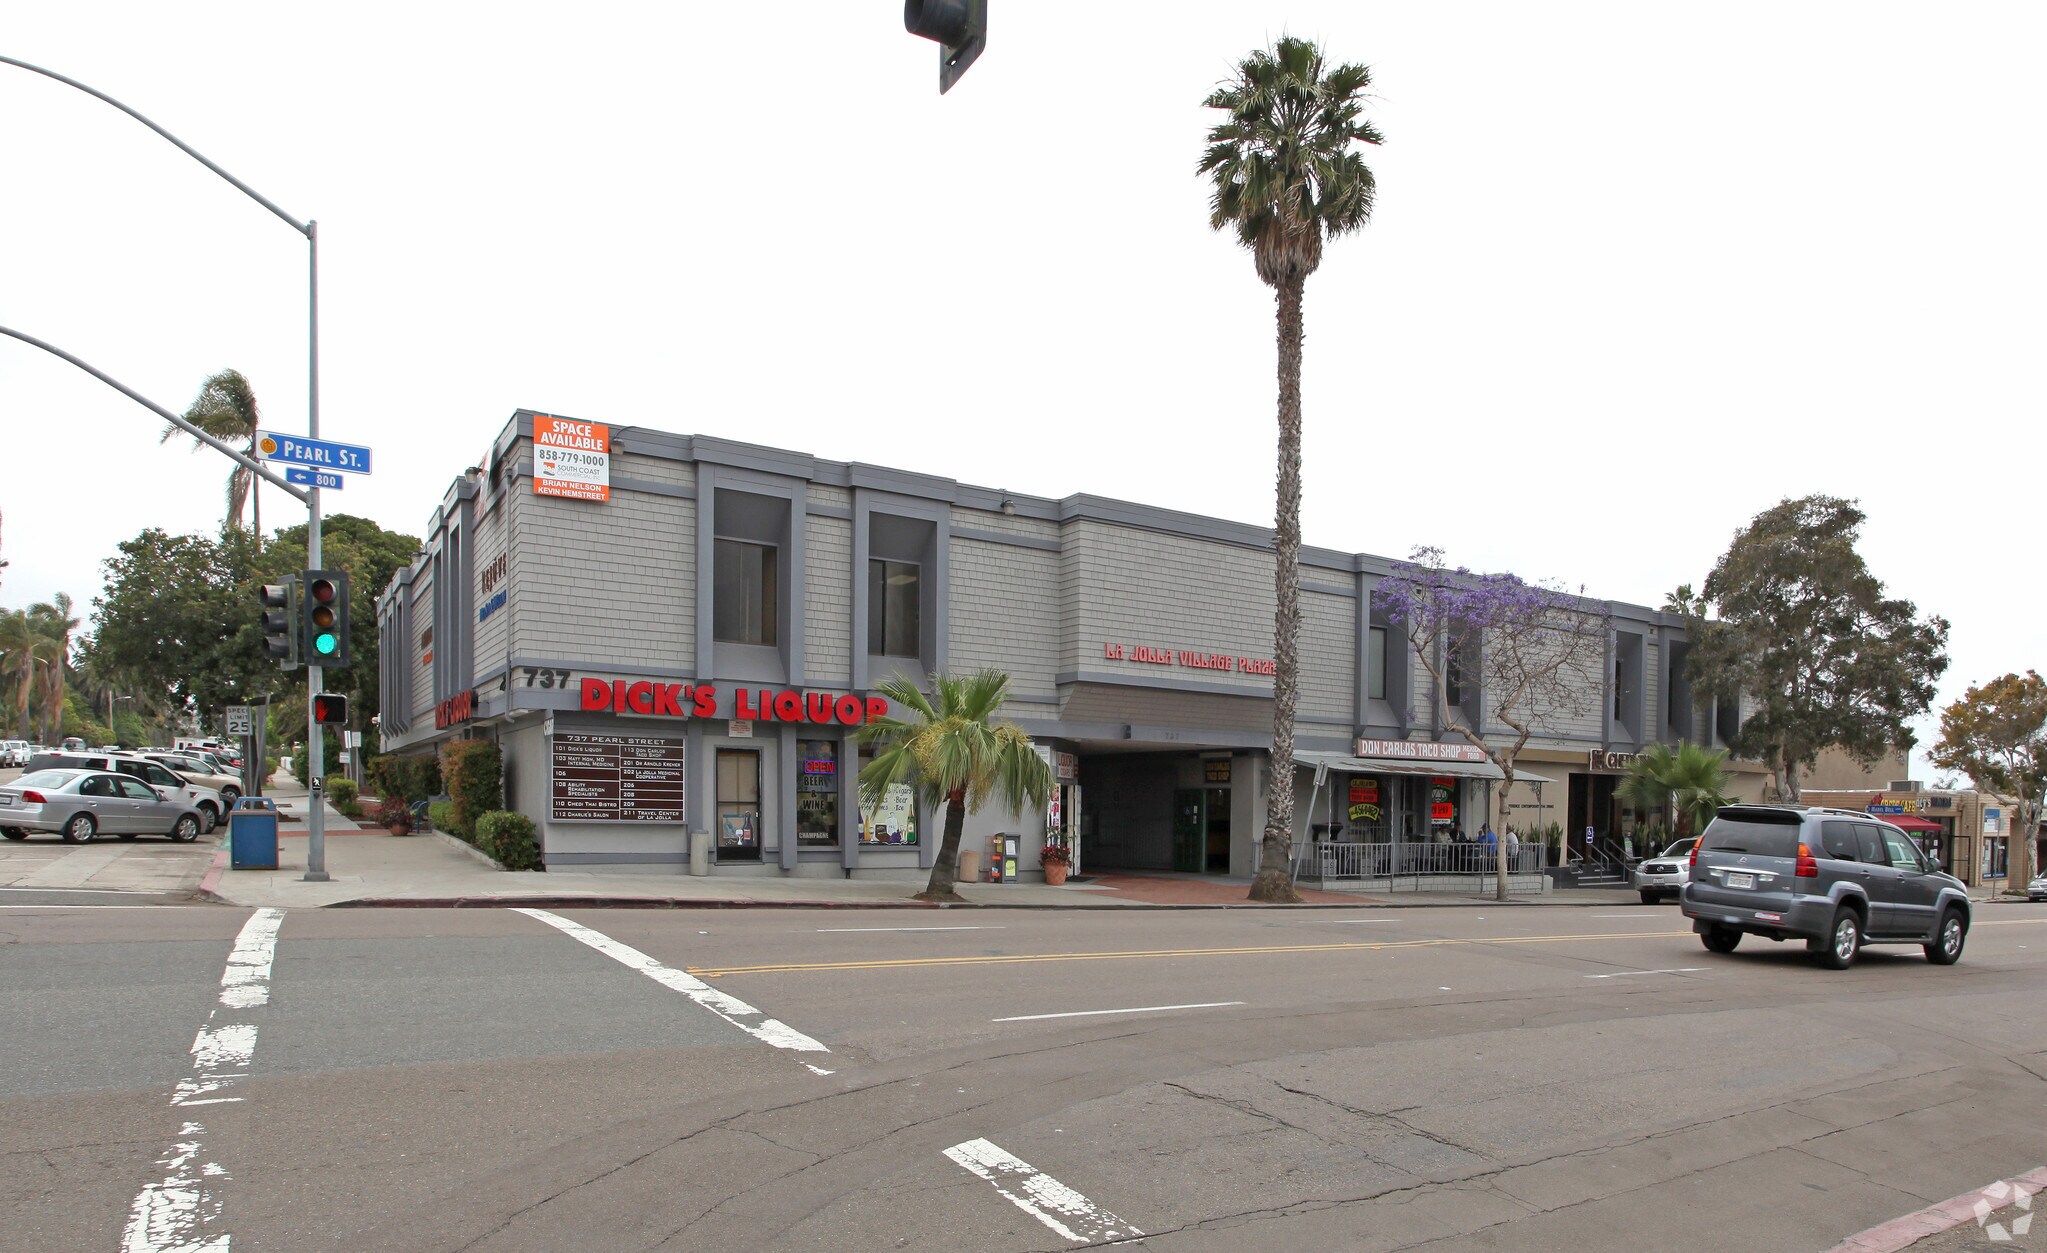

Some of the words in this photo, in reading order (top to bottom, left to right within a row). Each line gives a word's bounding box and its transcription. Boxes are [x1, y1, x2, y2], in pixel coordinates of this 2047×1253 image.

[552, 421, 592, 437] SPACE
[540, 432, 603, 451] AVAILABLE
[284, 440, 331, 463] PEARL
[339, 450, 361, 467] ST.
[539, 449, 604, 466] 858-779-1000
[579, 467, 600, 475] COAST
[316, 475, 336, 486] 800
[543, 479, 567, 488] BRIAN
[570, 483, 602, 491] NELSON
[538, 487, 560, 495] KEVIN
[562, 490, 605, 500] HEMSTREET
[1105, 642, 1123, 660] LA
[1129, 645, 1174, 665] JOLLA
[1178, 651, 1232, 671] VILLAGE
[1238, 657, 1276, 675] PLAZA
[523, 668, 571, 689] 737
[581, 678, 717, 718] DICK'S
[735, 688, 889, 725] LIQUOR
[230, 722, 249, 732] 25
[1362, 740, 1380, 755] DON
[1382, 741, 1416, 756] CARLOS
[1417, 743, 1438, 757] TACO
[1440, 745, 1460, 758] SHOP
[806, 761, 835, 773] OPEN
[804, 776, 824, 786] BEER
[811, 790, 817, 798] &
[803, 800, 824, 809] WINE
